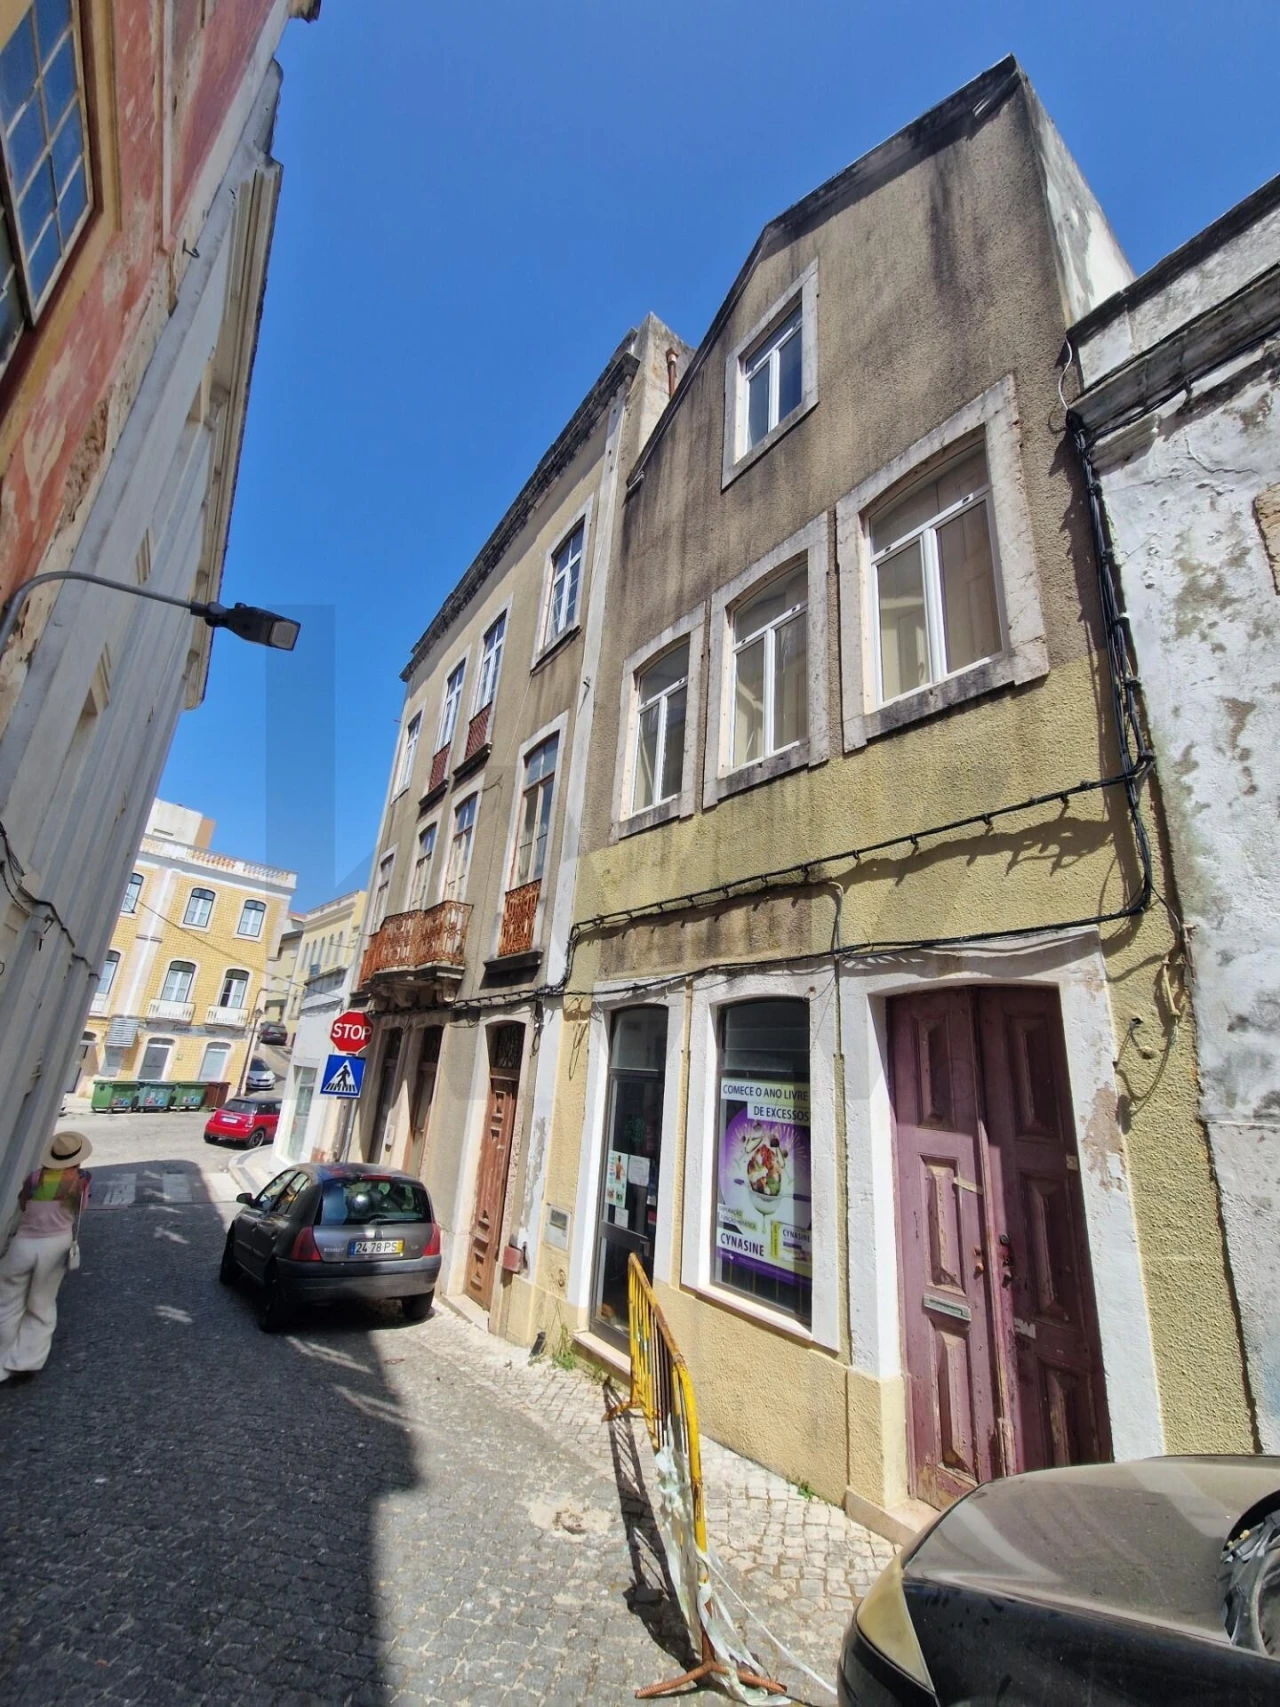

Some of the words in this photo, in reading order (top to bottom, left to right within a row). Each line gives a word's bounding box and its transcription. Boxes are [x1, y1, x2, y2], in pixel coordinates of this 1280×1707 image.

[332, 1023, 371, 1040] STOP
[723, 1084, 754, 1096] COMECE
[755, 1087, 762, 1097] O
[764, 1088, 782, 1099] ANO
[784, 1089, 809, 1101] LIVRE
[754, 1106, 764, 1116] DE
[766, 1107, 809, 1121] EXCESSOS
[356, 1242, 368, 1253] 24
[370, 1242, 382, 1252] 78
[384, 1242, 397, 1252] PS
[720, 1232, 764, 1257] CYNASINE
